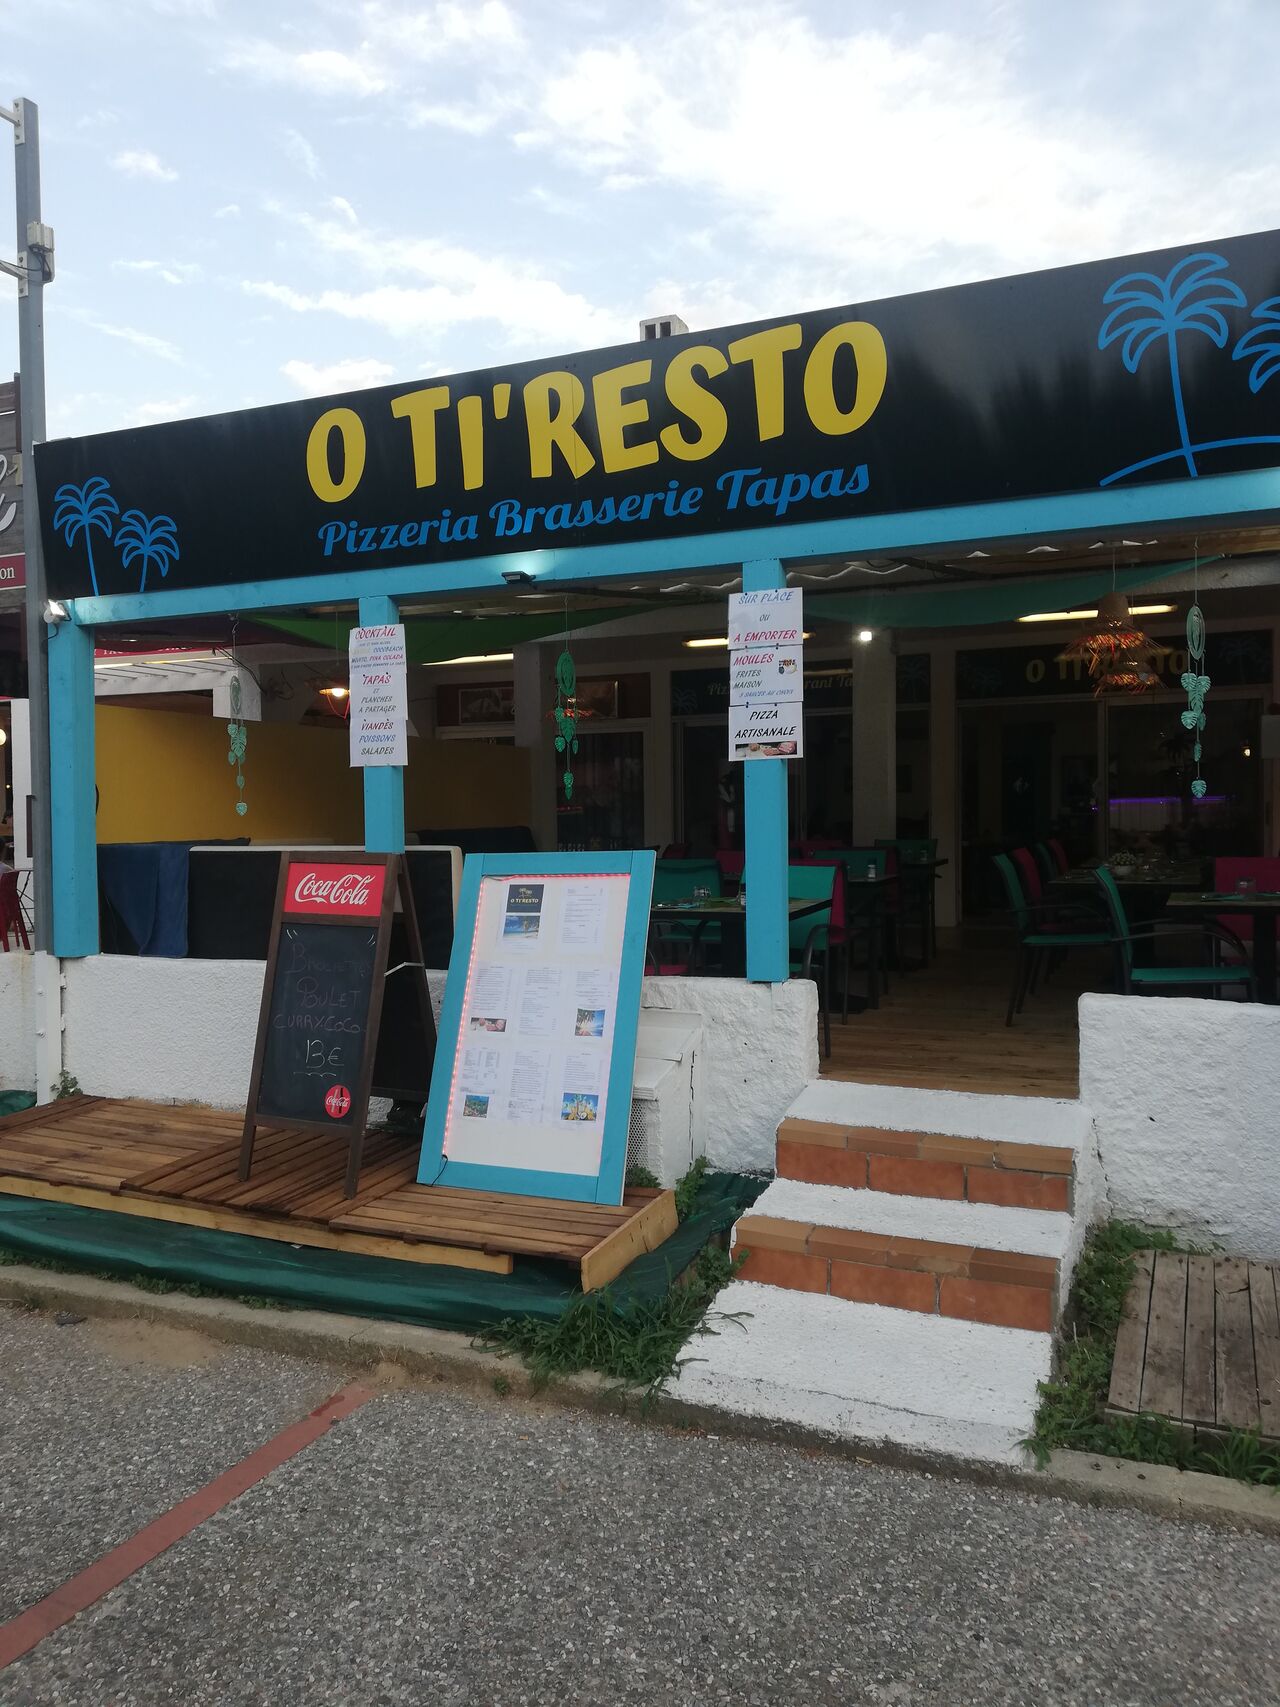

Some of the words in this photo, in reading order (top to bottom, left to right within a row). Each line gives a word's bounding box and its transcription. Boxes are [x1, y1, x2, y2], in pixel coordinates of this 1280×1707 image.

[306, 408, 366, 503] O
[390, 321, 888, 491] TI'RESTO
[318, 510, 479, 557] Pizzeria
[488, 480, 705, 538] Brasserie
[716, 463, 871, 517] Tapas
[738, 594, 758, 605] SUR
[761, 591, 793, 602] PLACE
[759, 614, 770, 622] OU
[355, 627, 397, 640] COCKTAIL
[734, 633, 741, 643] A
[744, 629, 798, 642] EMPORTER
[733, 653, 775, 666] MOULES
[362, 674, 392, 685] TAPAS
[736, 669, 762, 679] FRITES
[733, 680, 762, 690] MAISON
[361, 696, 393, 704] PLANCHES
[365, 705, 397, 714] PARTAGER
[749, 710, 778, 721] PIZZA
[361, 721, 394, 731] VIANDES
[735, 726, 797, 739] ARTISANALE
[359, 734, 396, 744] POISSONS
[361, 747, 395, 756] SALADES
[294, 872, 376, 906] Coca-Cola
